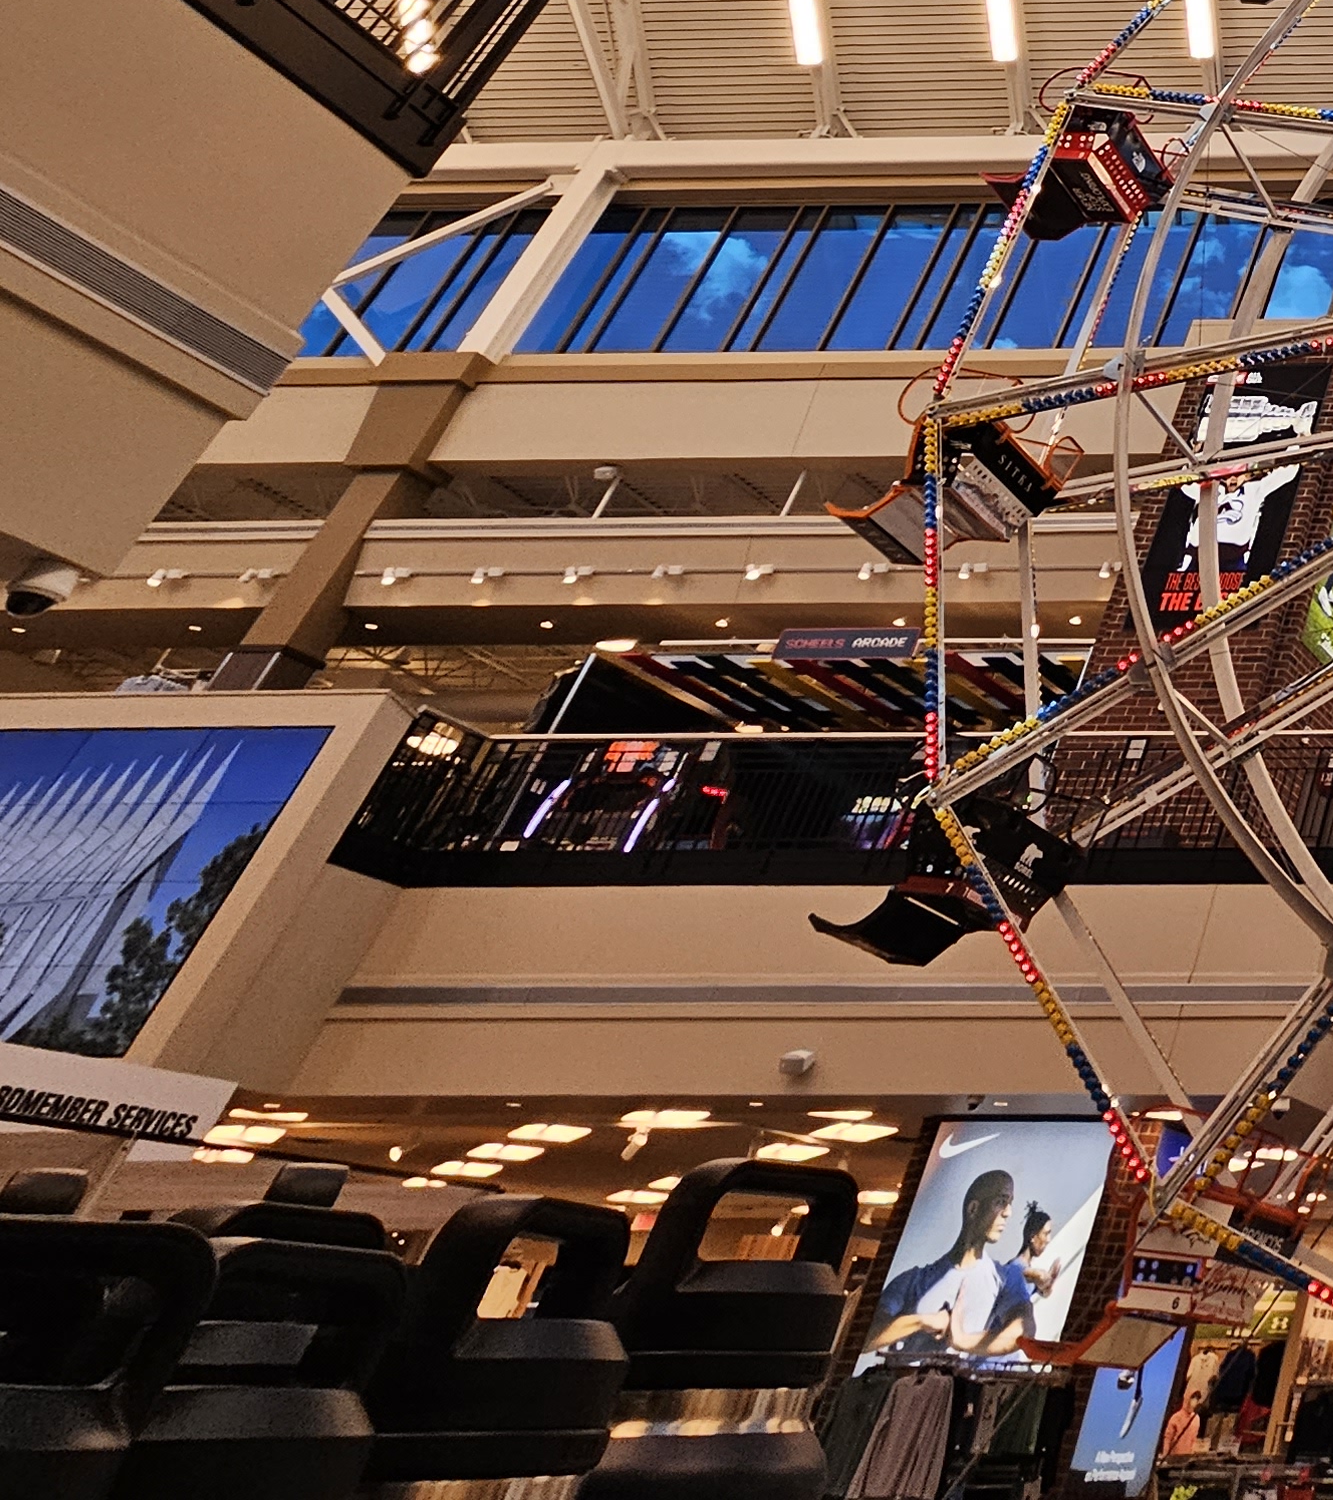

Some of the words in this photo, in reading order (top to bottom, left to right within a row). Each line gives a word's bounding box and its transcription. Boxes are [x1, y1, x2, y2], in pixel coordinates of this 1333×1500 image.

[1164, 572, 1184, 591] THE
[1159, 592, 1194, 611] THE
[785, 638, 845, 649] SCHEELS
[851, 637, 908, 649] ARCADE
[107, 1102, 199, 1138] SERVICES
[1171, 1296, 1180, 1310] 6
